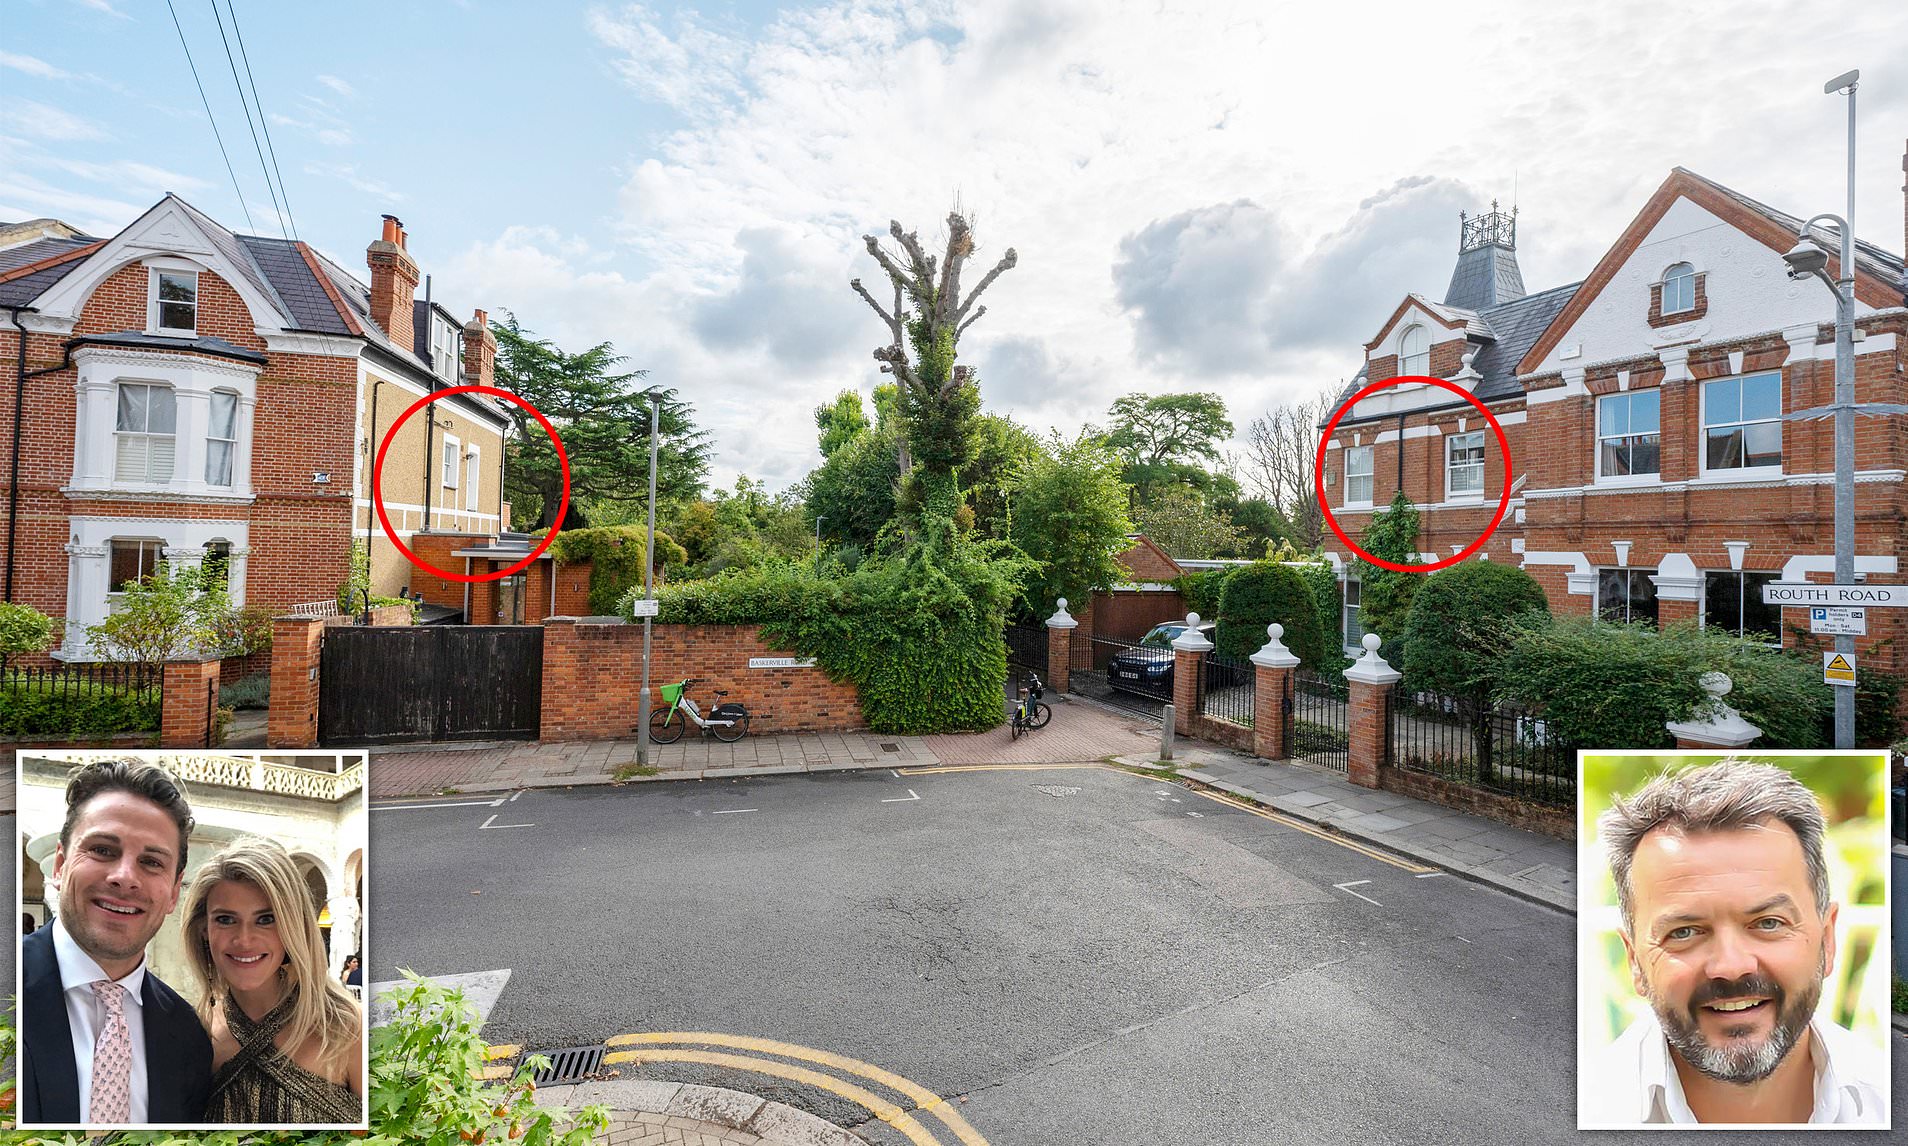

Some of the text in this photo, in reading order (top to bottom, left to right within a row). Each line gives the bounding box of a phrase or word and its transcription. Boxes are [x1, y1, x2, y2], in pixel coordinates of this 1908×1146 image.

[1769, 589, 1891, 601] ROUTH ROAD
[1815, 610, 1824, 619] P
